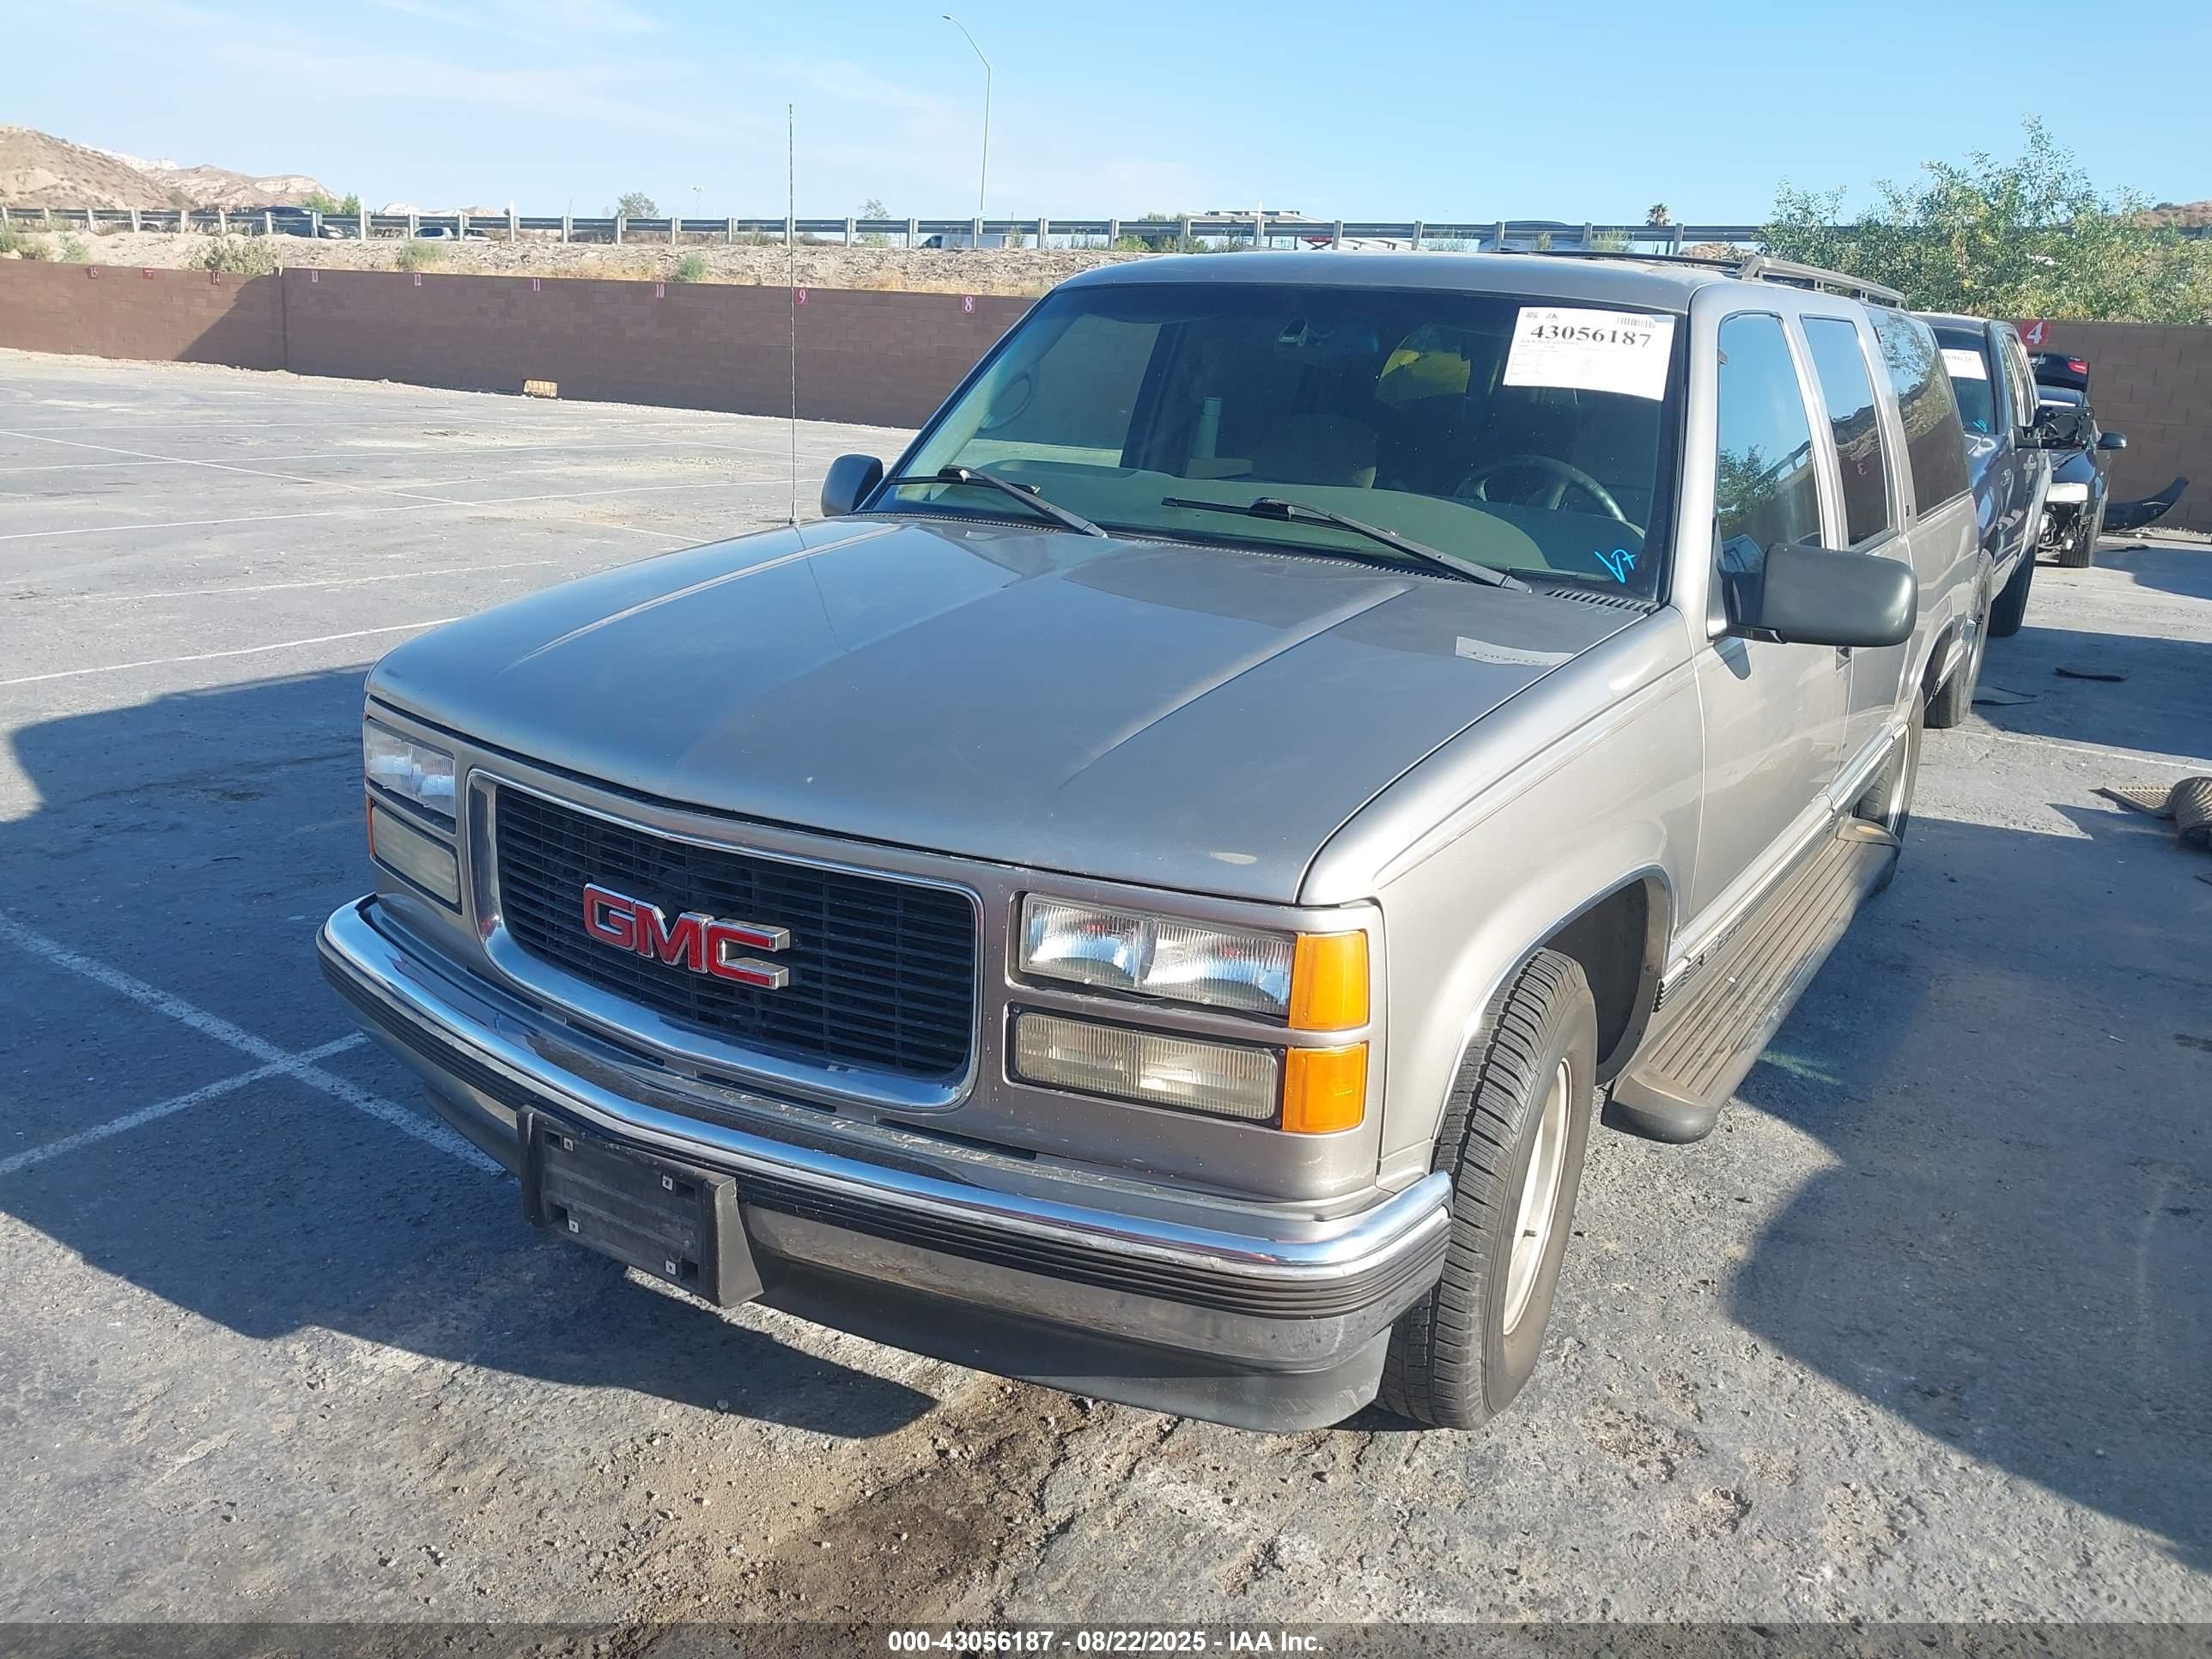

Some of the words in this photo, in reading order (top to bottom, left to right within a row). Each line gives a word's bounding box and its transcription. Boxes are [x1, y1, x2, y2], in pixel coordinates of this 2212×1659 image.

[212, 272, 221, 284] 14
[414, 273, 422, 286] 12
[533, 278, 541, 291] 11
[656, 283, 665, 298] 10
[799, 289, 806, 303] 9
[964, 295, 973, 313] 8
[1530, 325, 1652, 348] 43056187
[2027, 321, 2043, 344] 4
[583, 882, 790, 991] GMC
